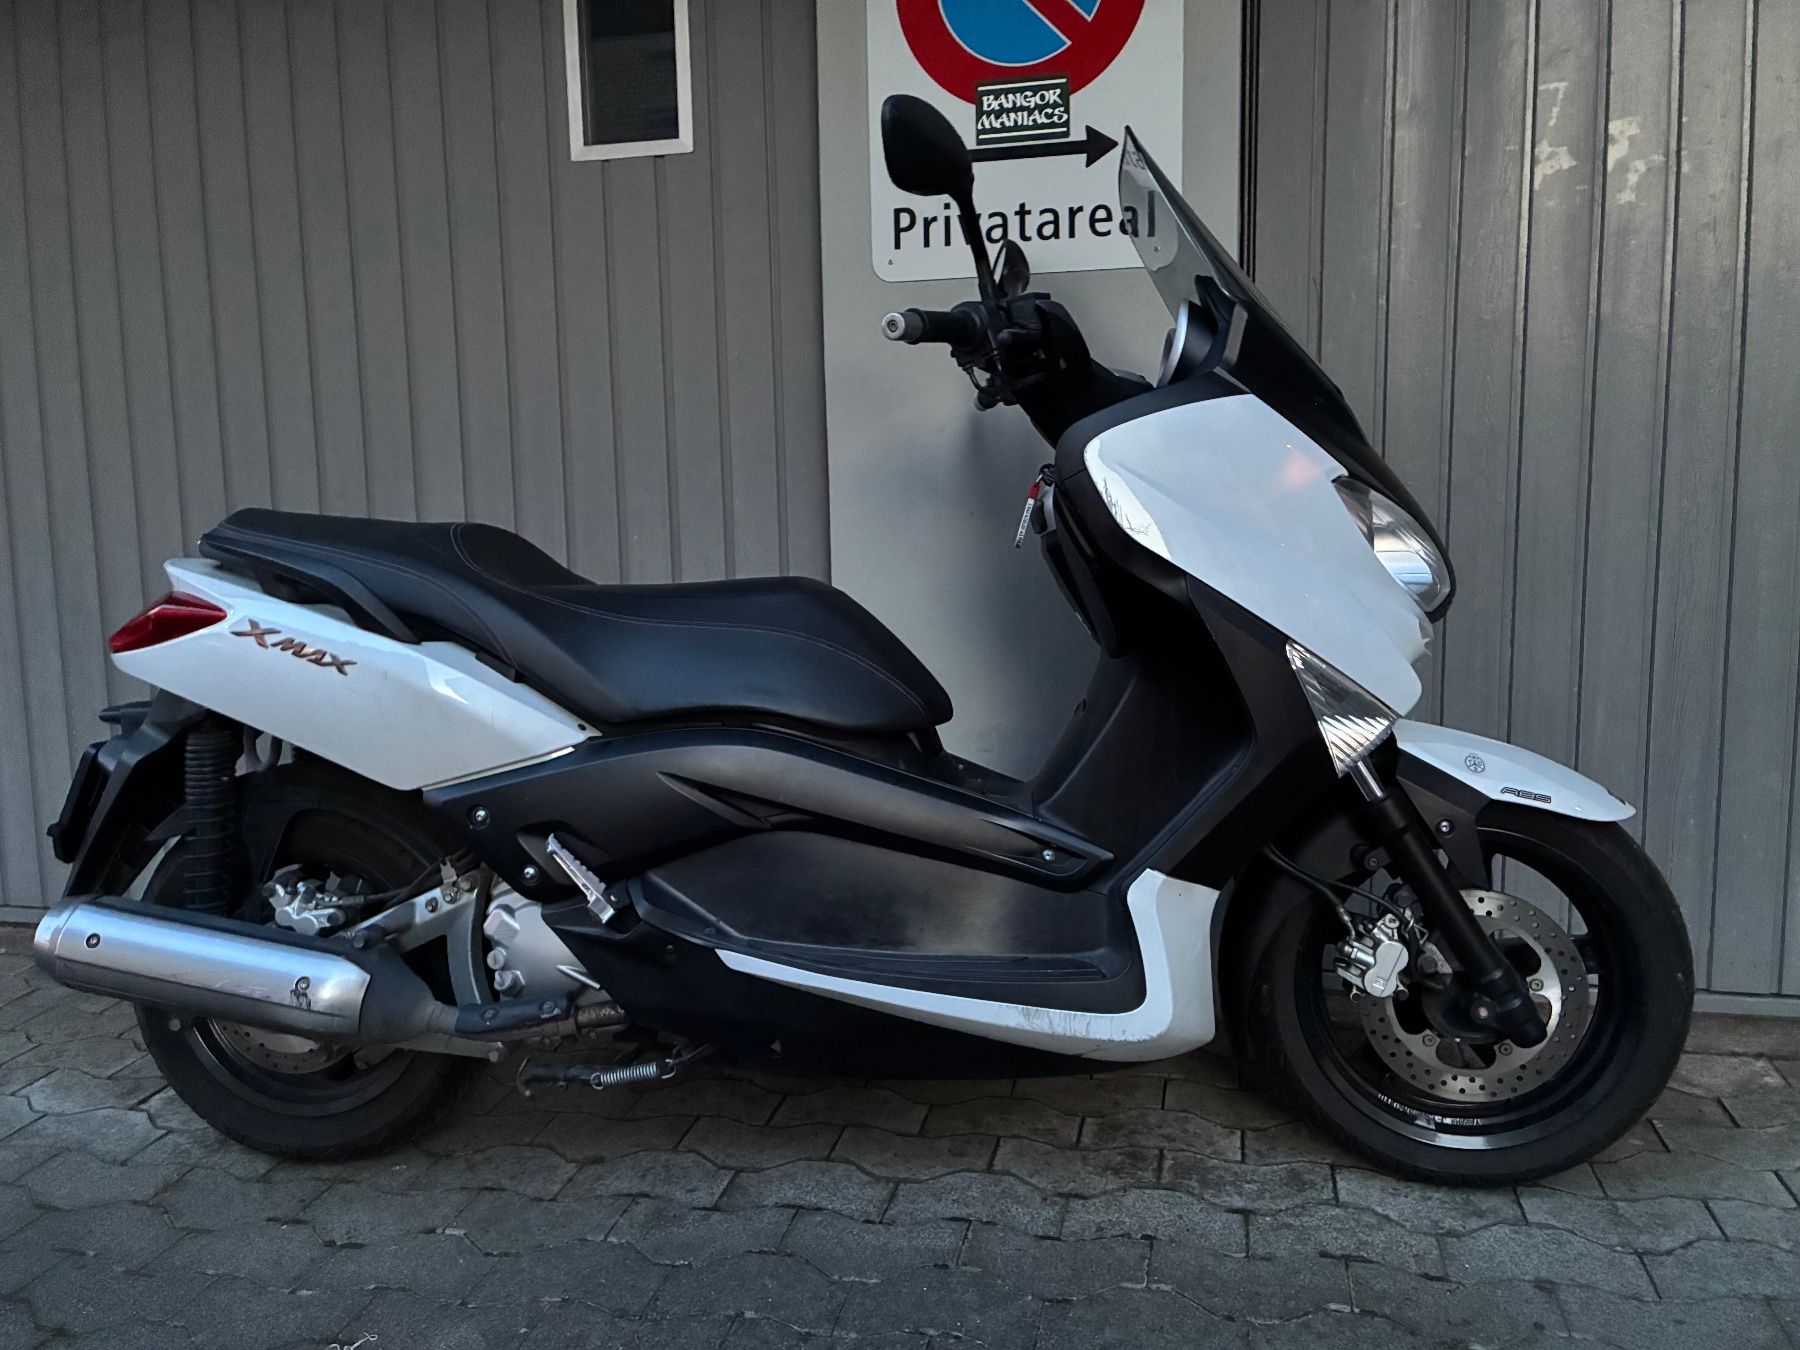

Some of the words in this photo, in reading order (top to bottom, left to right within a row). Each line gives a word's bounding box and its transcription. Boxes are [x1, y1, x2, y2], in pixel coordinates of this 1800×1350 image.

[982, 88, 1063, 111] BANGOR
[977, 107, 1068, 129] MANIACS
[1501, 786, 1552, 804] ABS
